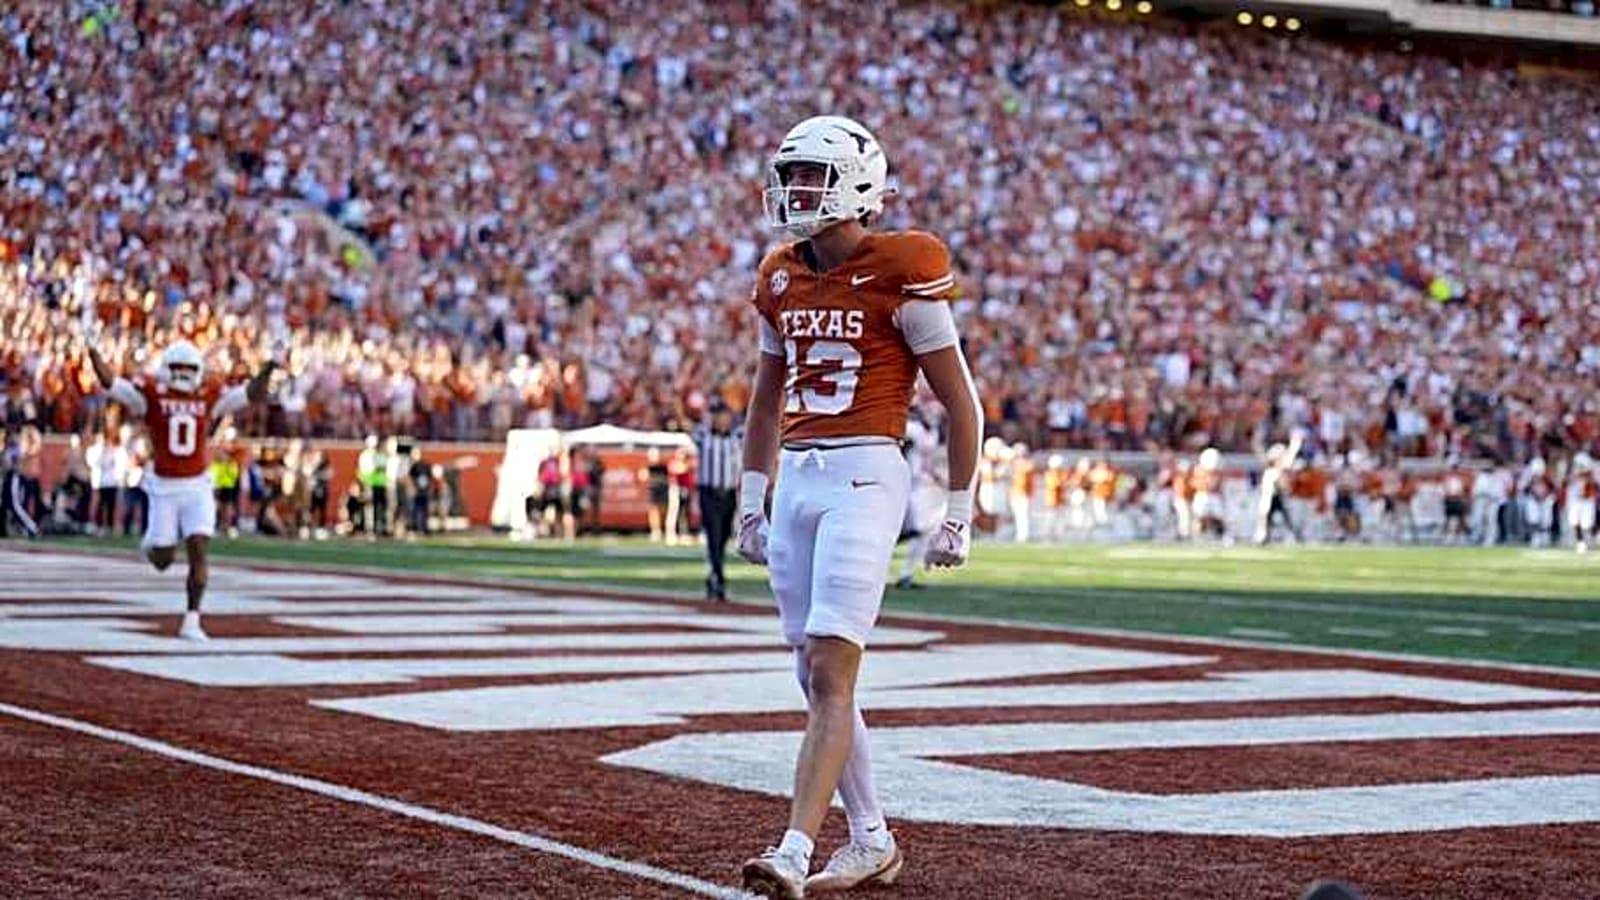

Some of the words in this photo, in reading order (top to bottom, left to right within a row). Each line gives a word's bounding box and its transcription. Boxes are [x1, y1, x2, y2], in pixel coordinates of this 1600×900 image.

[781, 310, 865, 338] TEXAS
[784, 340, 863, 415] 13
[158, 399, 206, 415] TEXAS
[168, 414, 198, 456] 0
